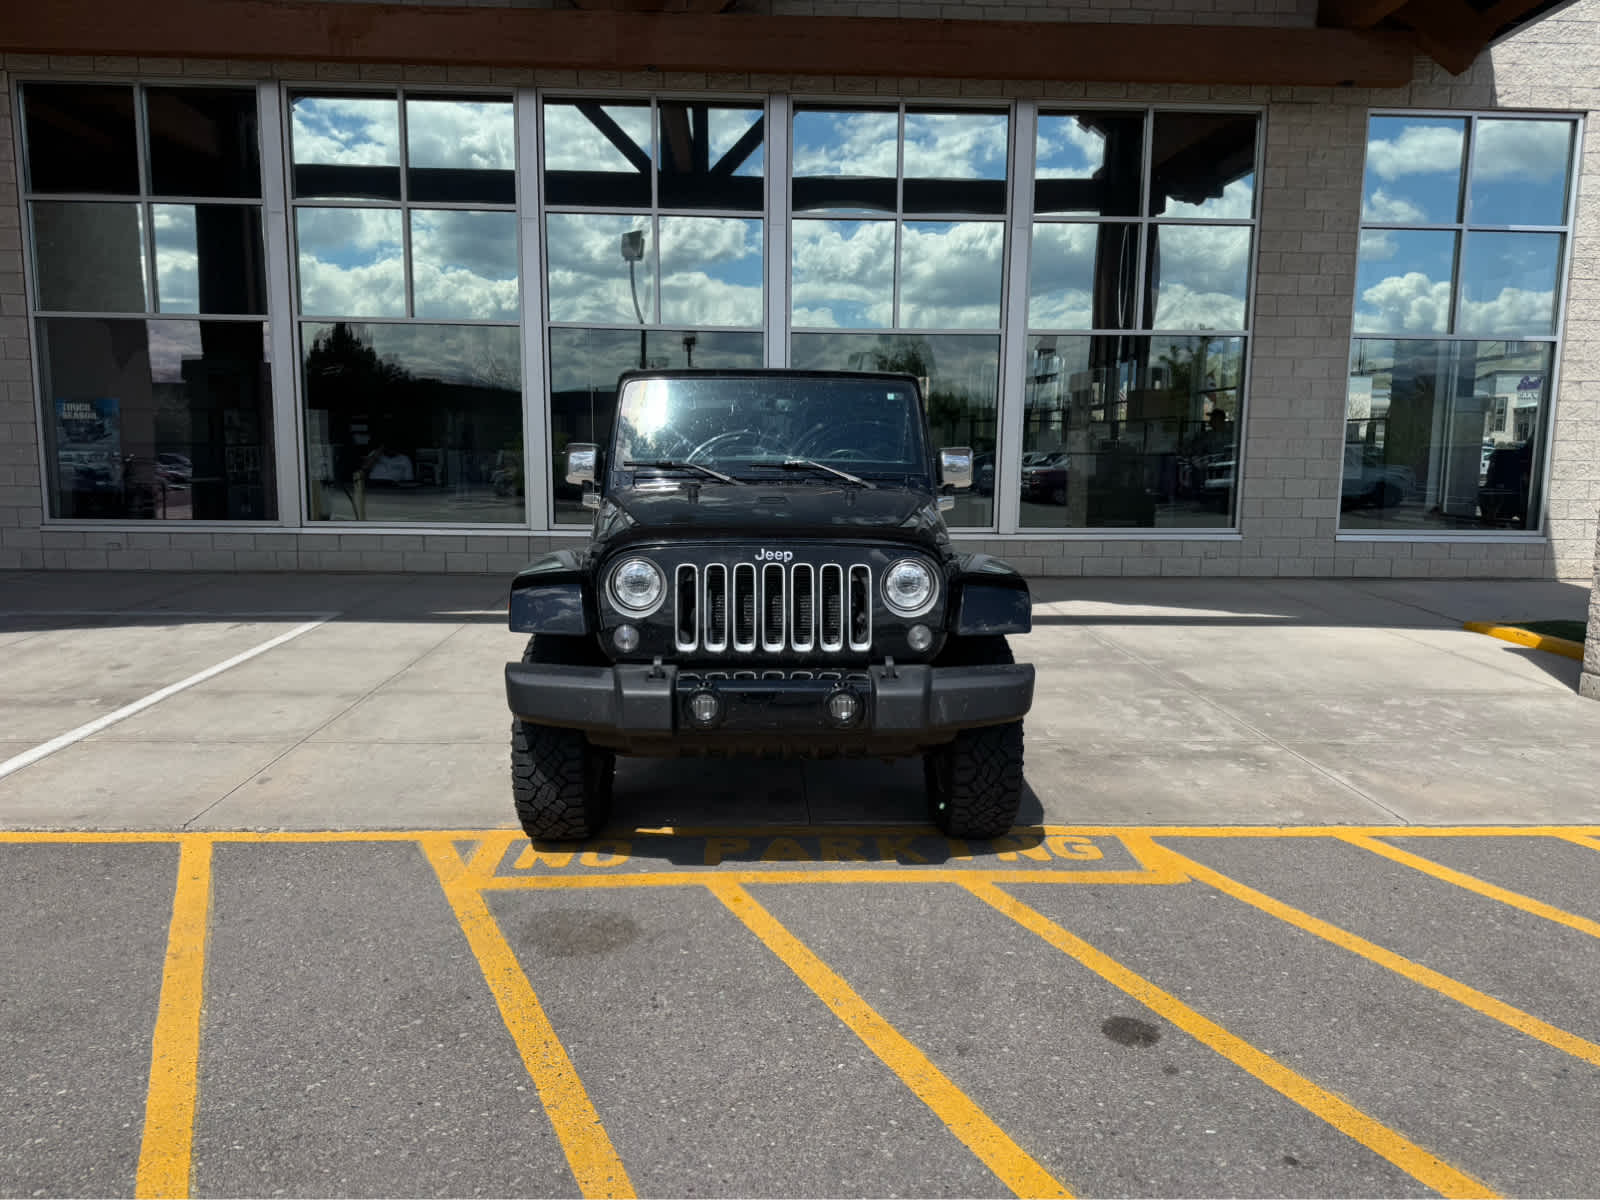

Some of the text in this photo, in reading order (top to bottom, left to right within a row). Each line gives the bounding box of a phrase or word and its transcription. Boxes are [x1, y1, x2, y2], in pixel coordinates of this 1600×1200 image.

[754, 547, 793, 563] Jeep
[512, 835, 1104, 869] NO PARKING
